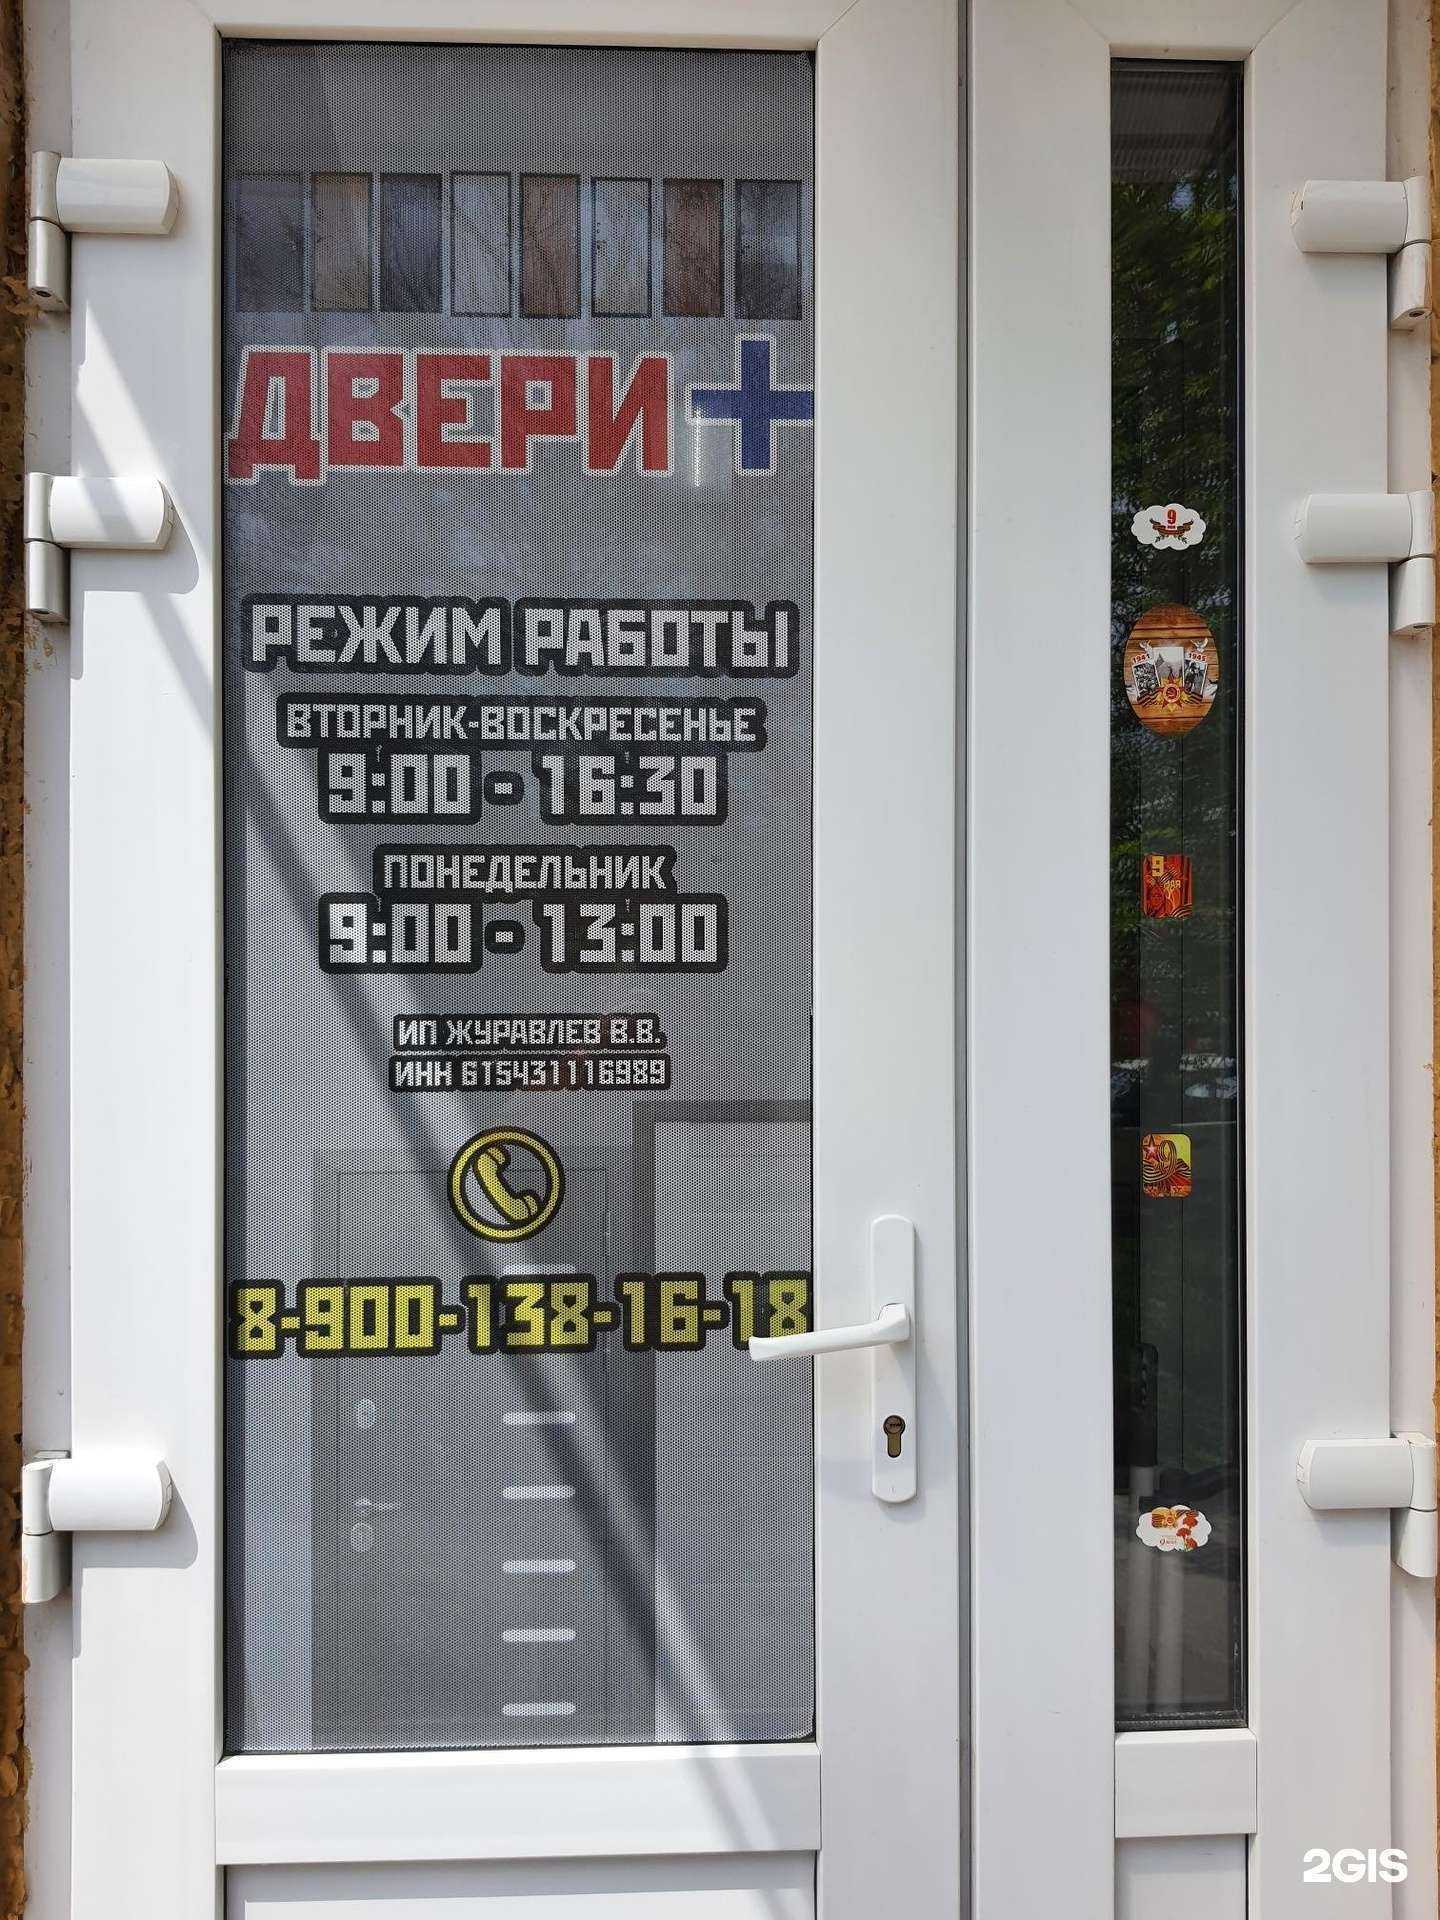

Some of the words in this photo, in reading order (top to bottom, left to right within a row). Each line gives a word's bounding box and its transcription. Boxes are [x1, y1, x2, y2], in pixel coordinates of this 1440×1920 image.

[251, 604, 501, 664] РЕЖИМ
[525, 608, 789, 667] РАБОТЫ
[286, 703, 756, 742] ВТОРНИК-ВОСКРЕСЕНЬЕ
[328, 753, 471, 814] 9:00
[541, 756, 718, 815] 16:30
[383, 855, 666, 893] ПОНЕДЕЛЬНИК
[329, 904, 472, 963] 9:00
[543, 904, 718, 963] 13:00
[399, 1020, 437, 1045] ИП
[446, 1019, 600, 1044] ЖУРАВЛЕВ
[611, 1019, 660, 1044] В.В.
[395, 1061, 451, 1086] ИНН
[238, 1279, 807, 1352] 8-900-138-16-18
